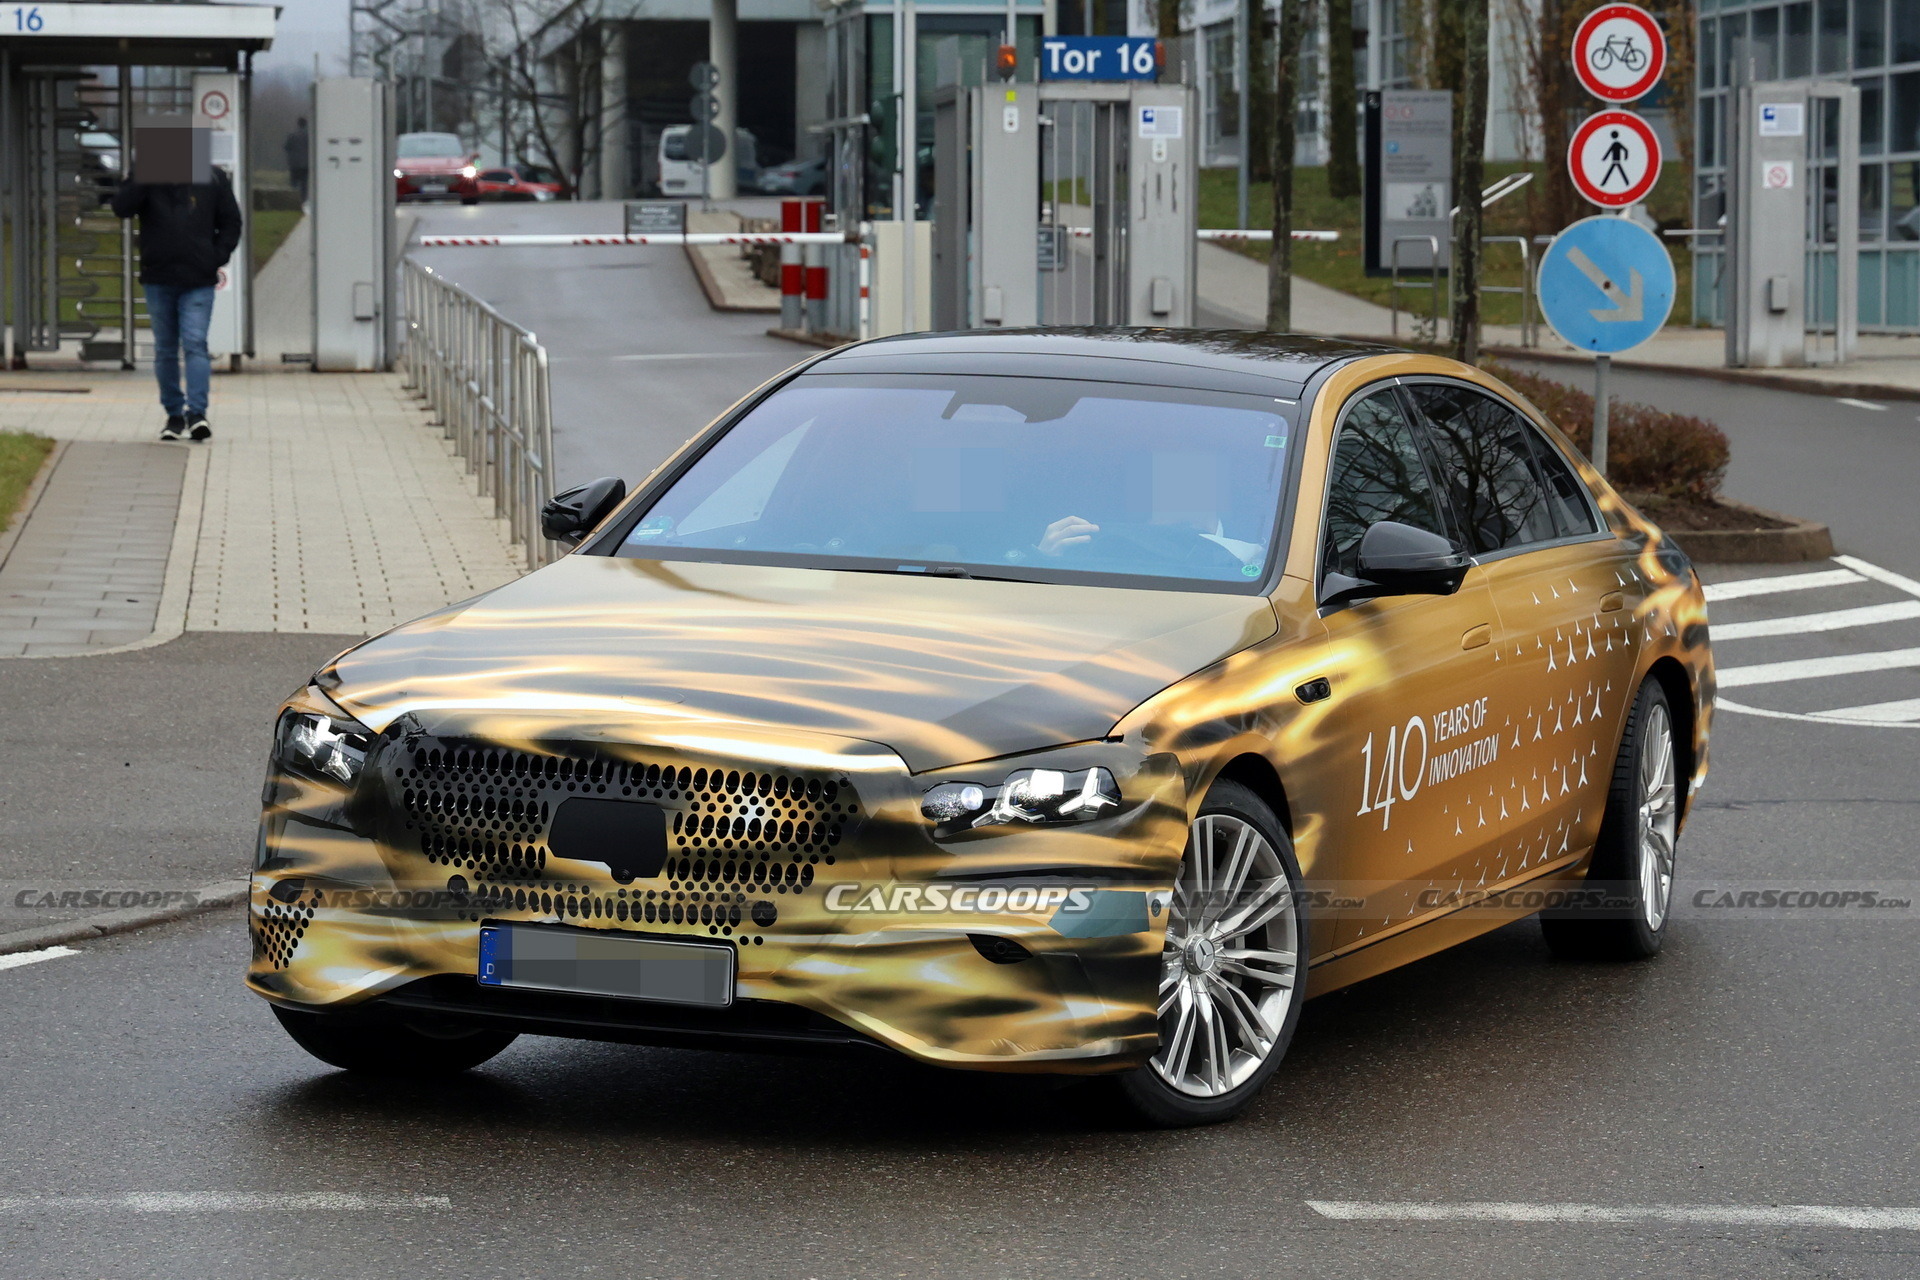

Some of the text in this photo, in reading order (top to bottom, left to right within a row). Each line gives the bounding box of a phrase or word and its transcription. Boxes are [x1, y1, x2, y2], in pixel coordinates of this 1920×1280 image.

[13, 7, 43, 31] 16
[1044, 42, 1154, 74] Tor 16
[1433, 696, 1488, 743] YEARS OF
[1356, 715, 1427, 831] 140
[1428, 733, 1500, 787] INNOVATION
[486, 962, 495, 975] D
